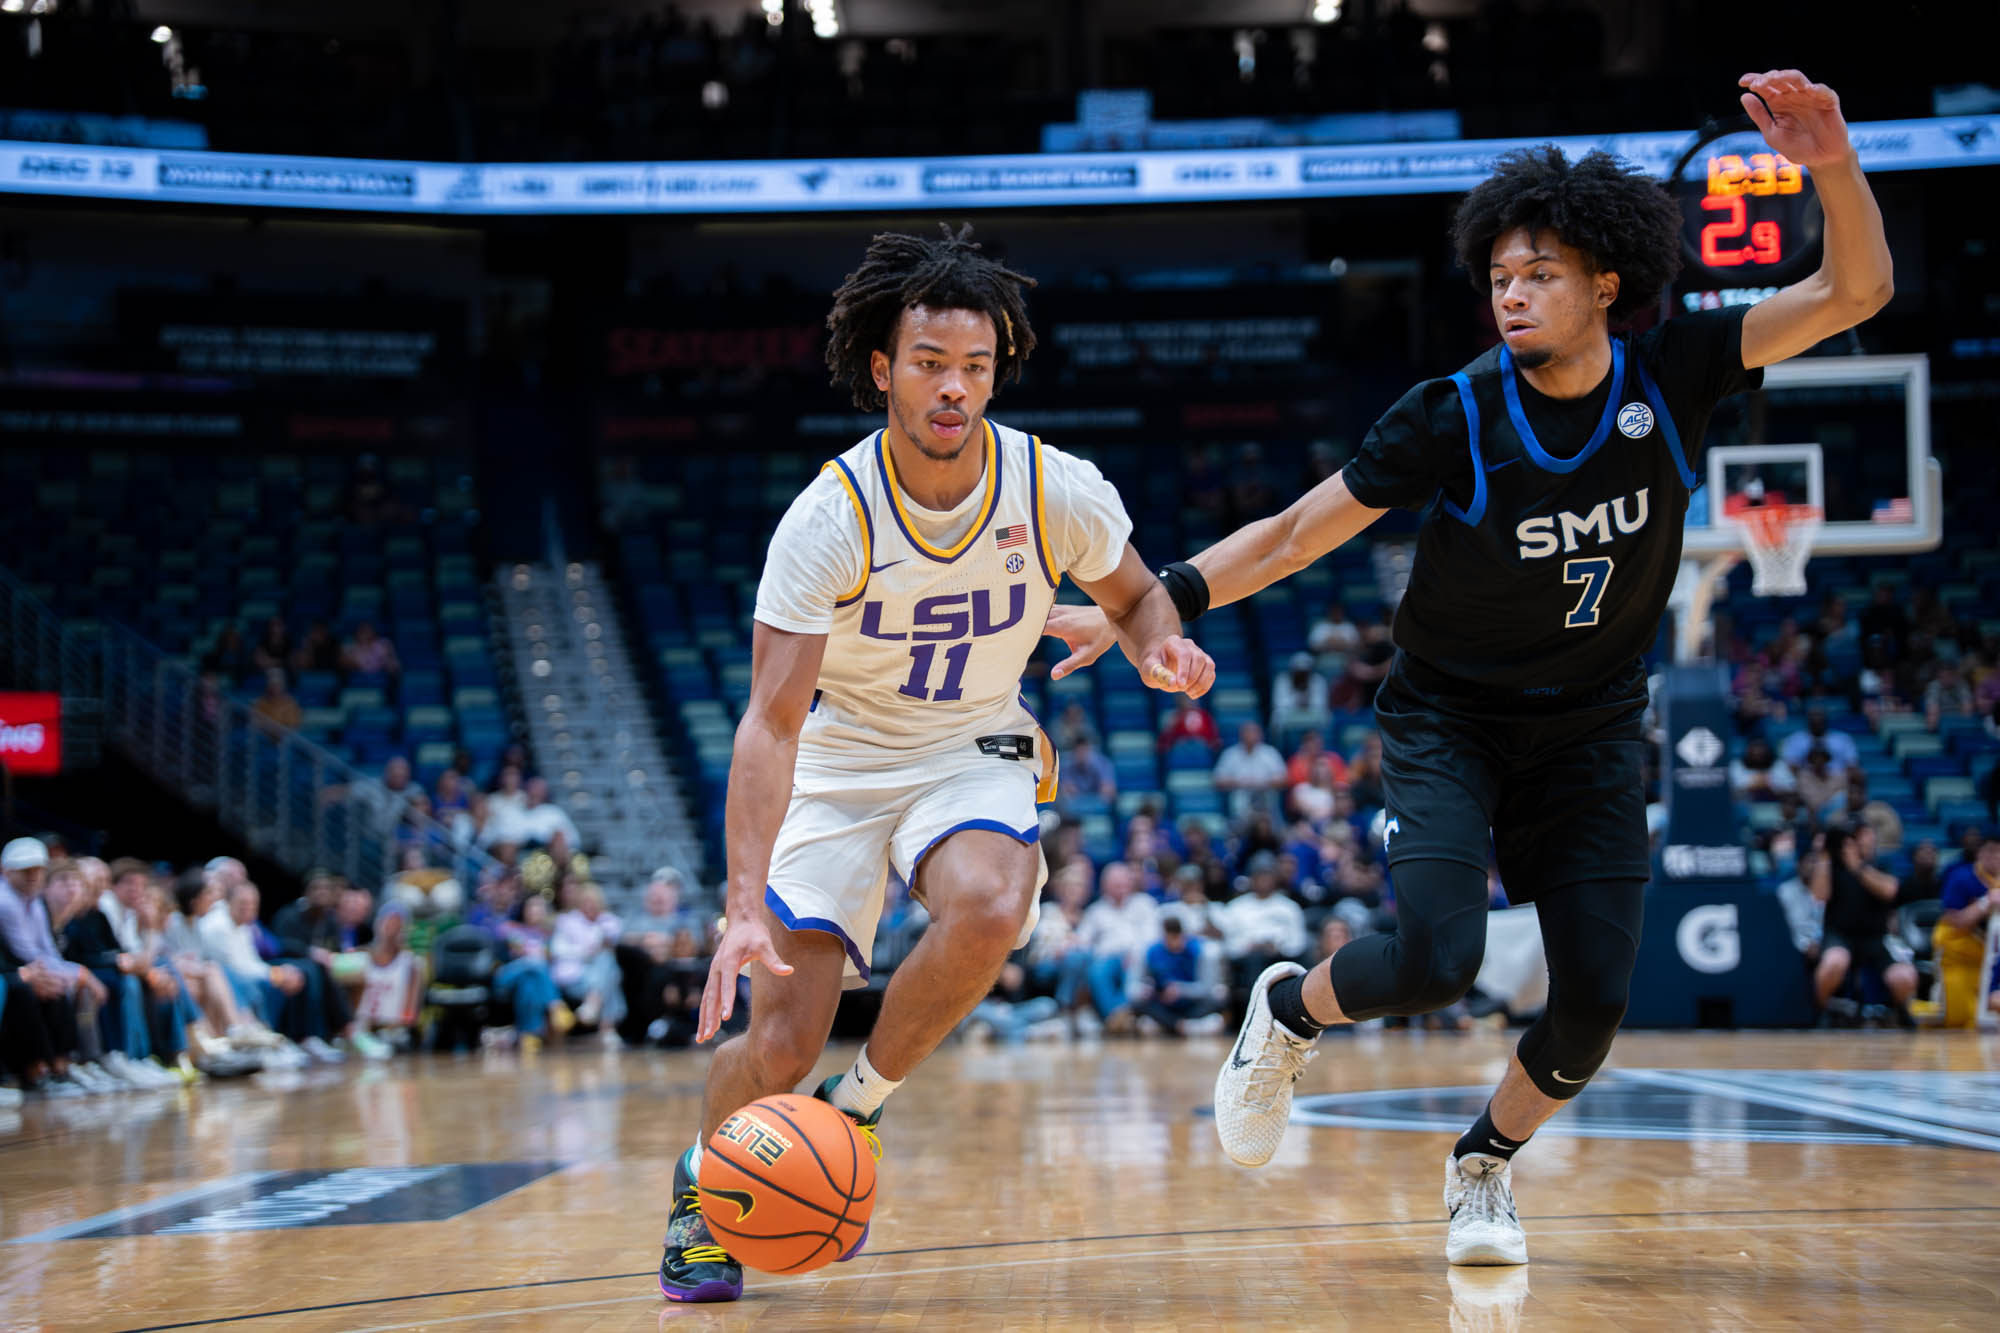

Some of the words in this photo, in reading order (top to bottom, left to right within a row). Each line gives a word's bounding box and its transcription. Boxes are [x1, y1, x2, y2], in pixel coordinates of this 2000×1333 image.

[1700, 194, 1781, 266] 2.9
[1623, 411, 1649, 426] ACC
[1516, 487, 1649, 559] SMU
[1006, 554, 1024, 573] SEC
[1563, 556, 1614, 628] 7
[859, 582, 1027, 641] LSU
[897, 642, 973, 701] 11
[1676, 903, 1741, 974] G
[717, 1114, 787, 1168] ELITE
